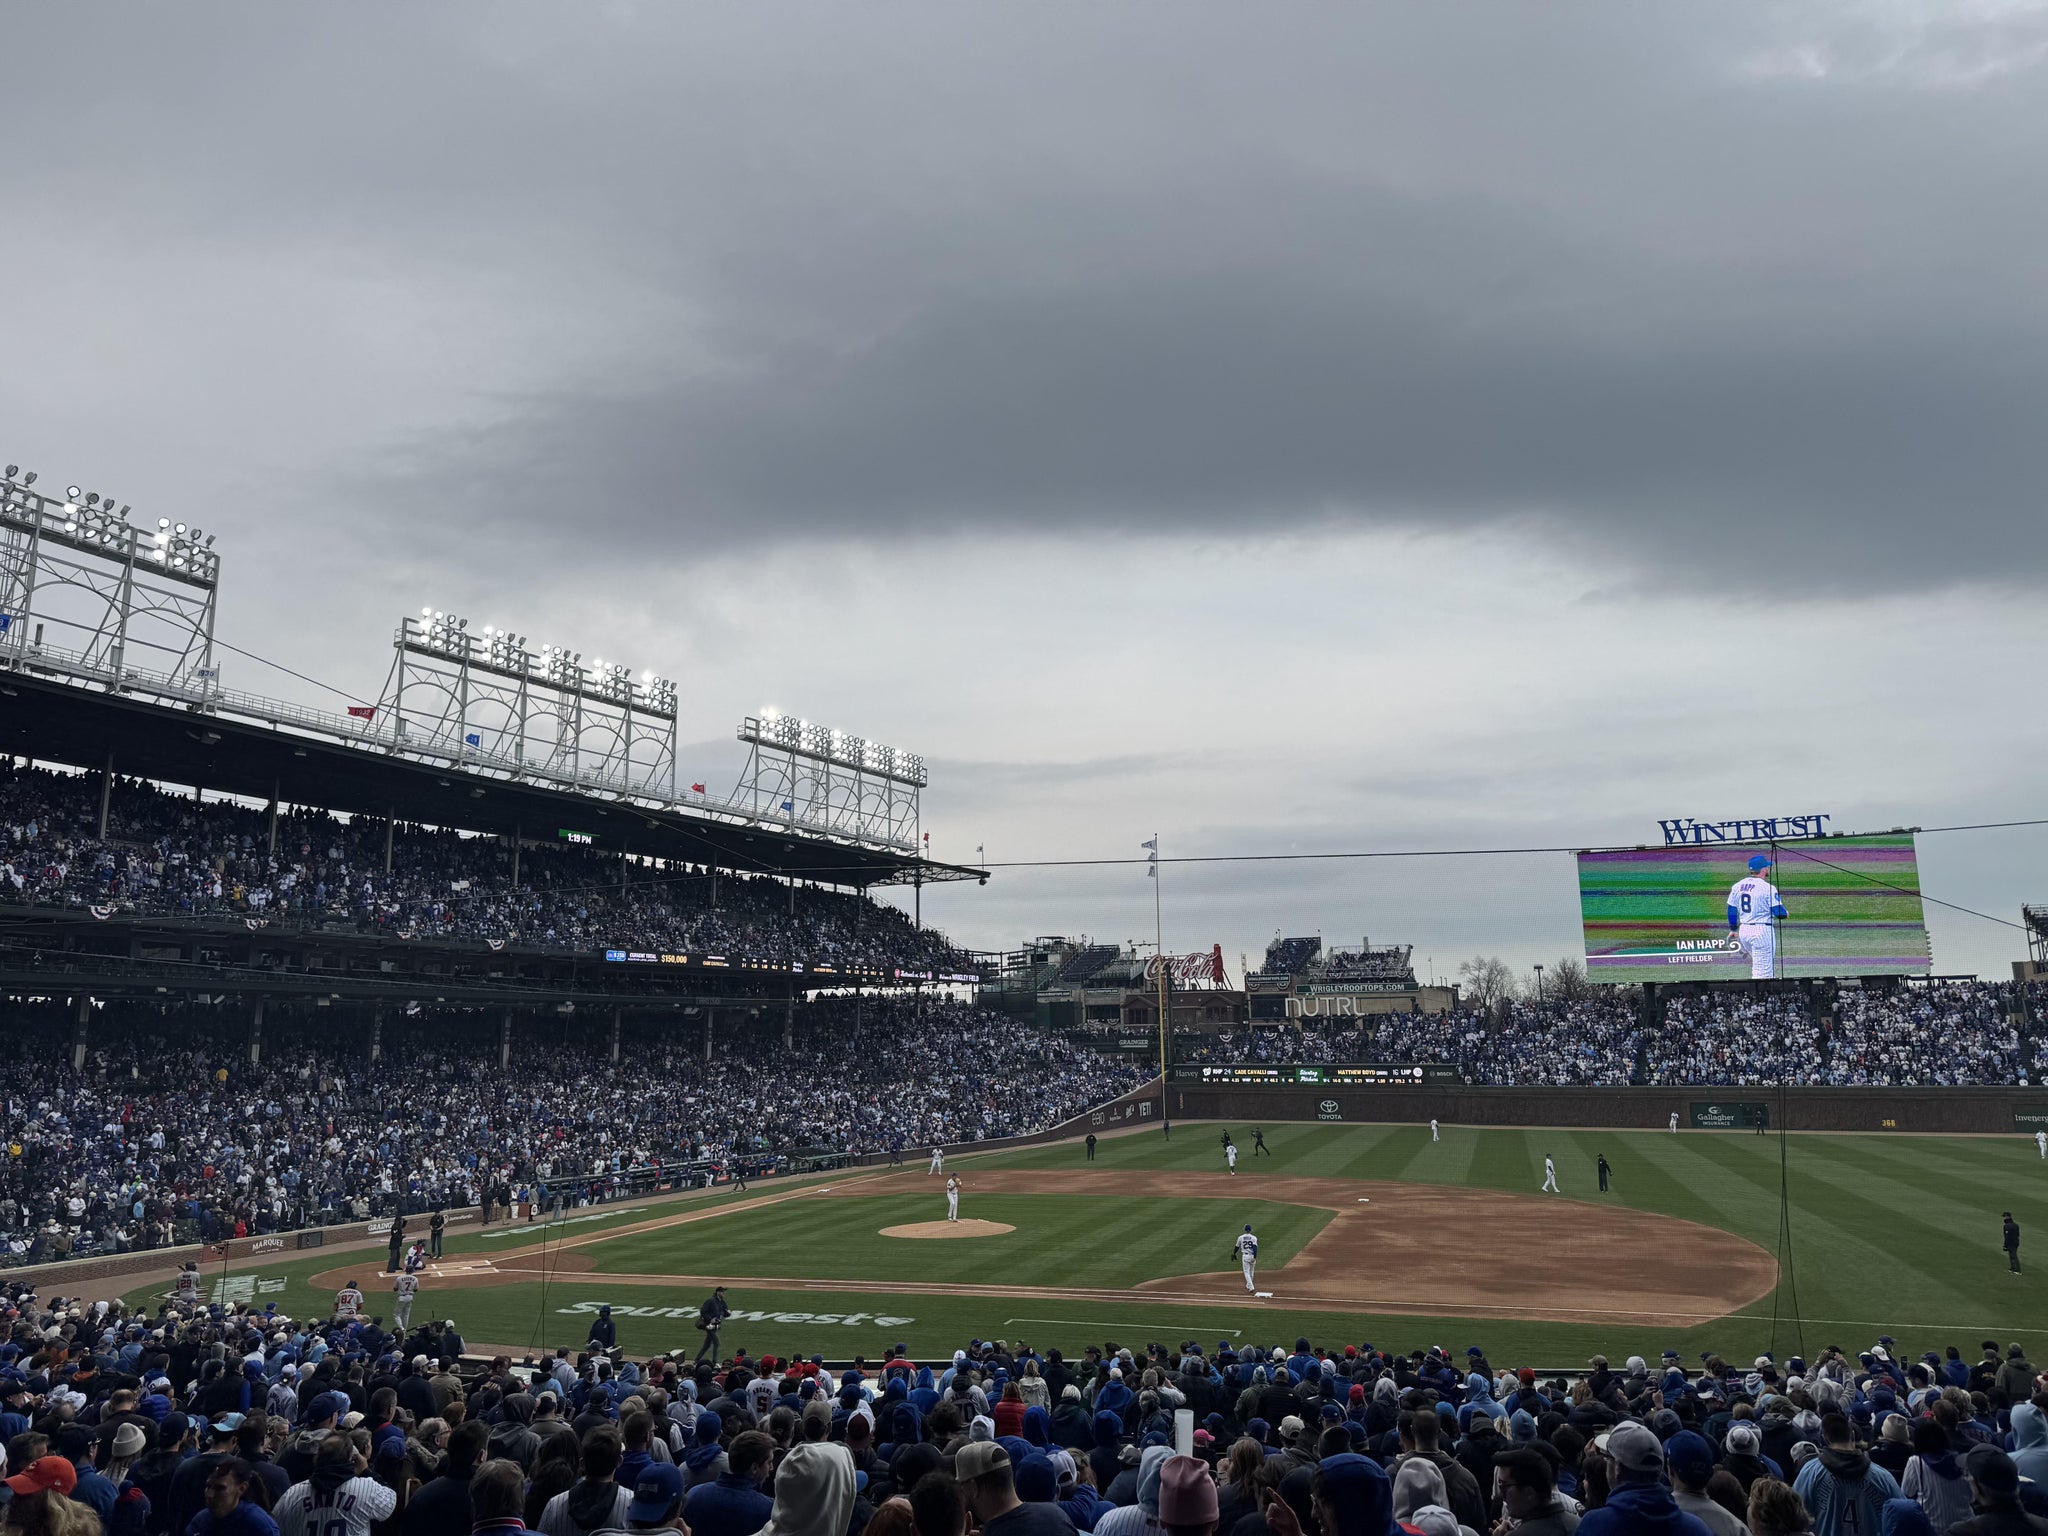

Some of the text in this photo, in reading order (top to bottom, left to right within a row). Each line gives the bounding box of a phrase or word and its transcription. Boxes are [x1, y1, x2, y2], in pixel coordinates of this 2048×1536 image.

[1657, 814, 1830, 844] WINTRUST
[567, 832, 592, 844] 1:19 PM
[1740, 884, 1755, 892] HAPP
[1741, 893, 1751, 913] 8
[1676, 939, 1725, 950] IAN HAPP
[661, 954, 688, 964] $150,000
[1685, 955, 1713, 963] FIELDER
[1144, 953, 1217, 980] Coca-Cola
[1175, 1070, 1199, 1078] Harvey
[1139, 1102, 1152, 1116] YETI
[1697, 1113, 1734, 1121] Gallagher
[1882, 1119, 1896, 1127] 368
[367, 1221, 395, 1232] GRAING
[252, 1238, 284, 1251] MARQUEE
[1243, 1241, 1253, 1249] 29
[180, 1279, 192, 1288] 29
[405, 1281, 412, 1291] 7
[341, 1295, 354, 1304] 87
[752, 1387, 774, 1396] ABRAMS
[757, 1396, 768, 1413] 5
[303, 1490, 356, 1512] SANTO
[1843, 1499, 1859, 1534] 4
